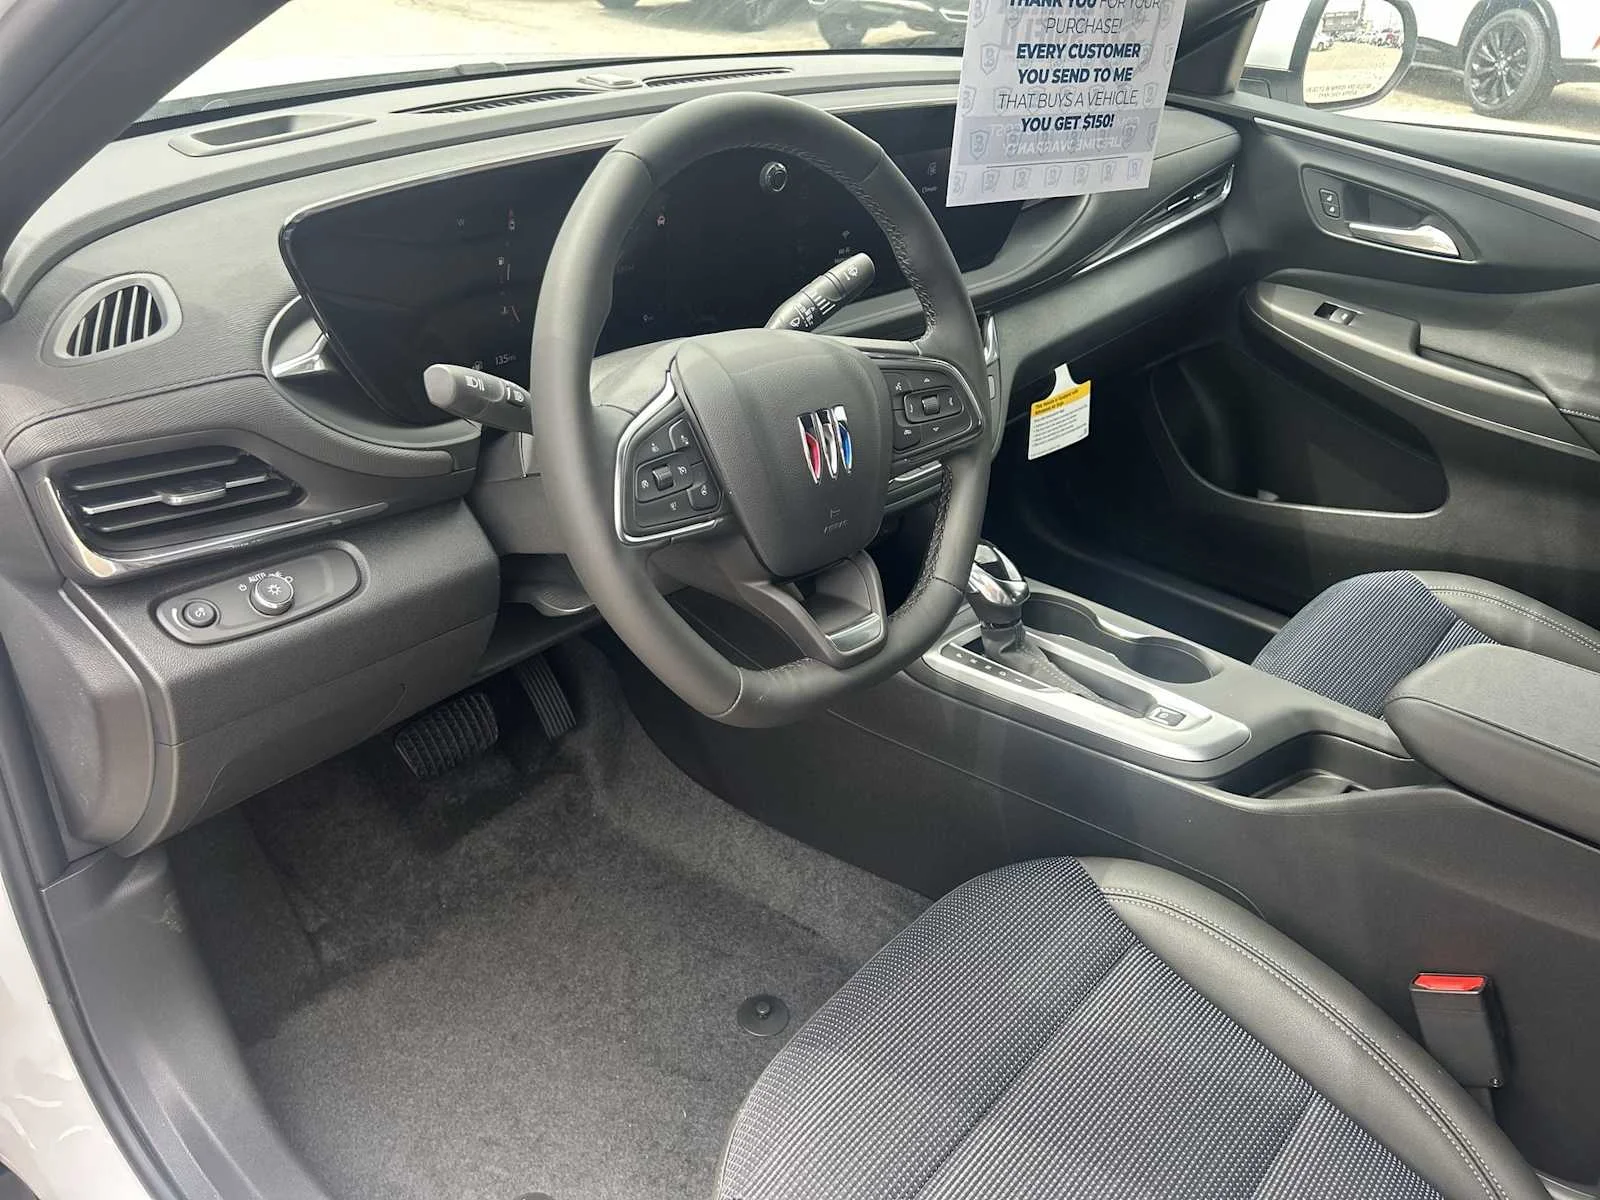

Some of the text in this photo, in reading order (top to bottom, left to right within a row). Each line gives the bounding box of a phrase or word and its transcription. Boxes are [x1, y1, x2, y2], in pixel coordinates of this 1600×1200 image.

[1046, 17, 1122, 34] PURCHASE!
[1016, 43, 1141, 59] EVERY CUSTOMER
[1018, 67, 1133, 84] YOU SEND TO ME
[999, 93, 1036, 109] THAT
[1037, 92, 1072, 108] BUYS
[1075, 92, 1084, 106] A
[1021, 117, 1050, 132] YOU
[1055, 116, 1081, 130] GET
[1082, 114, 1115, 131] $150!
[248, 572, 266, 583] AUTO
